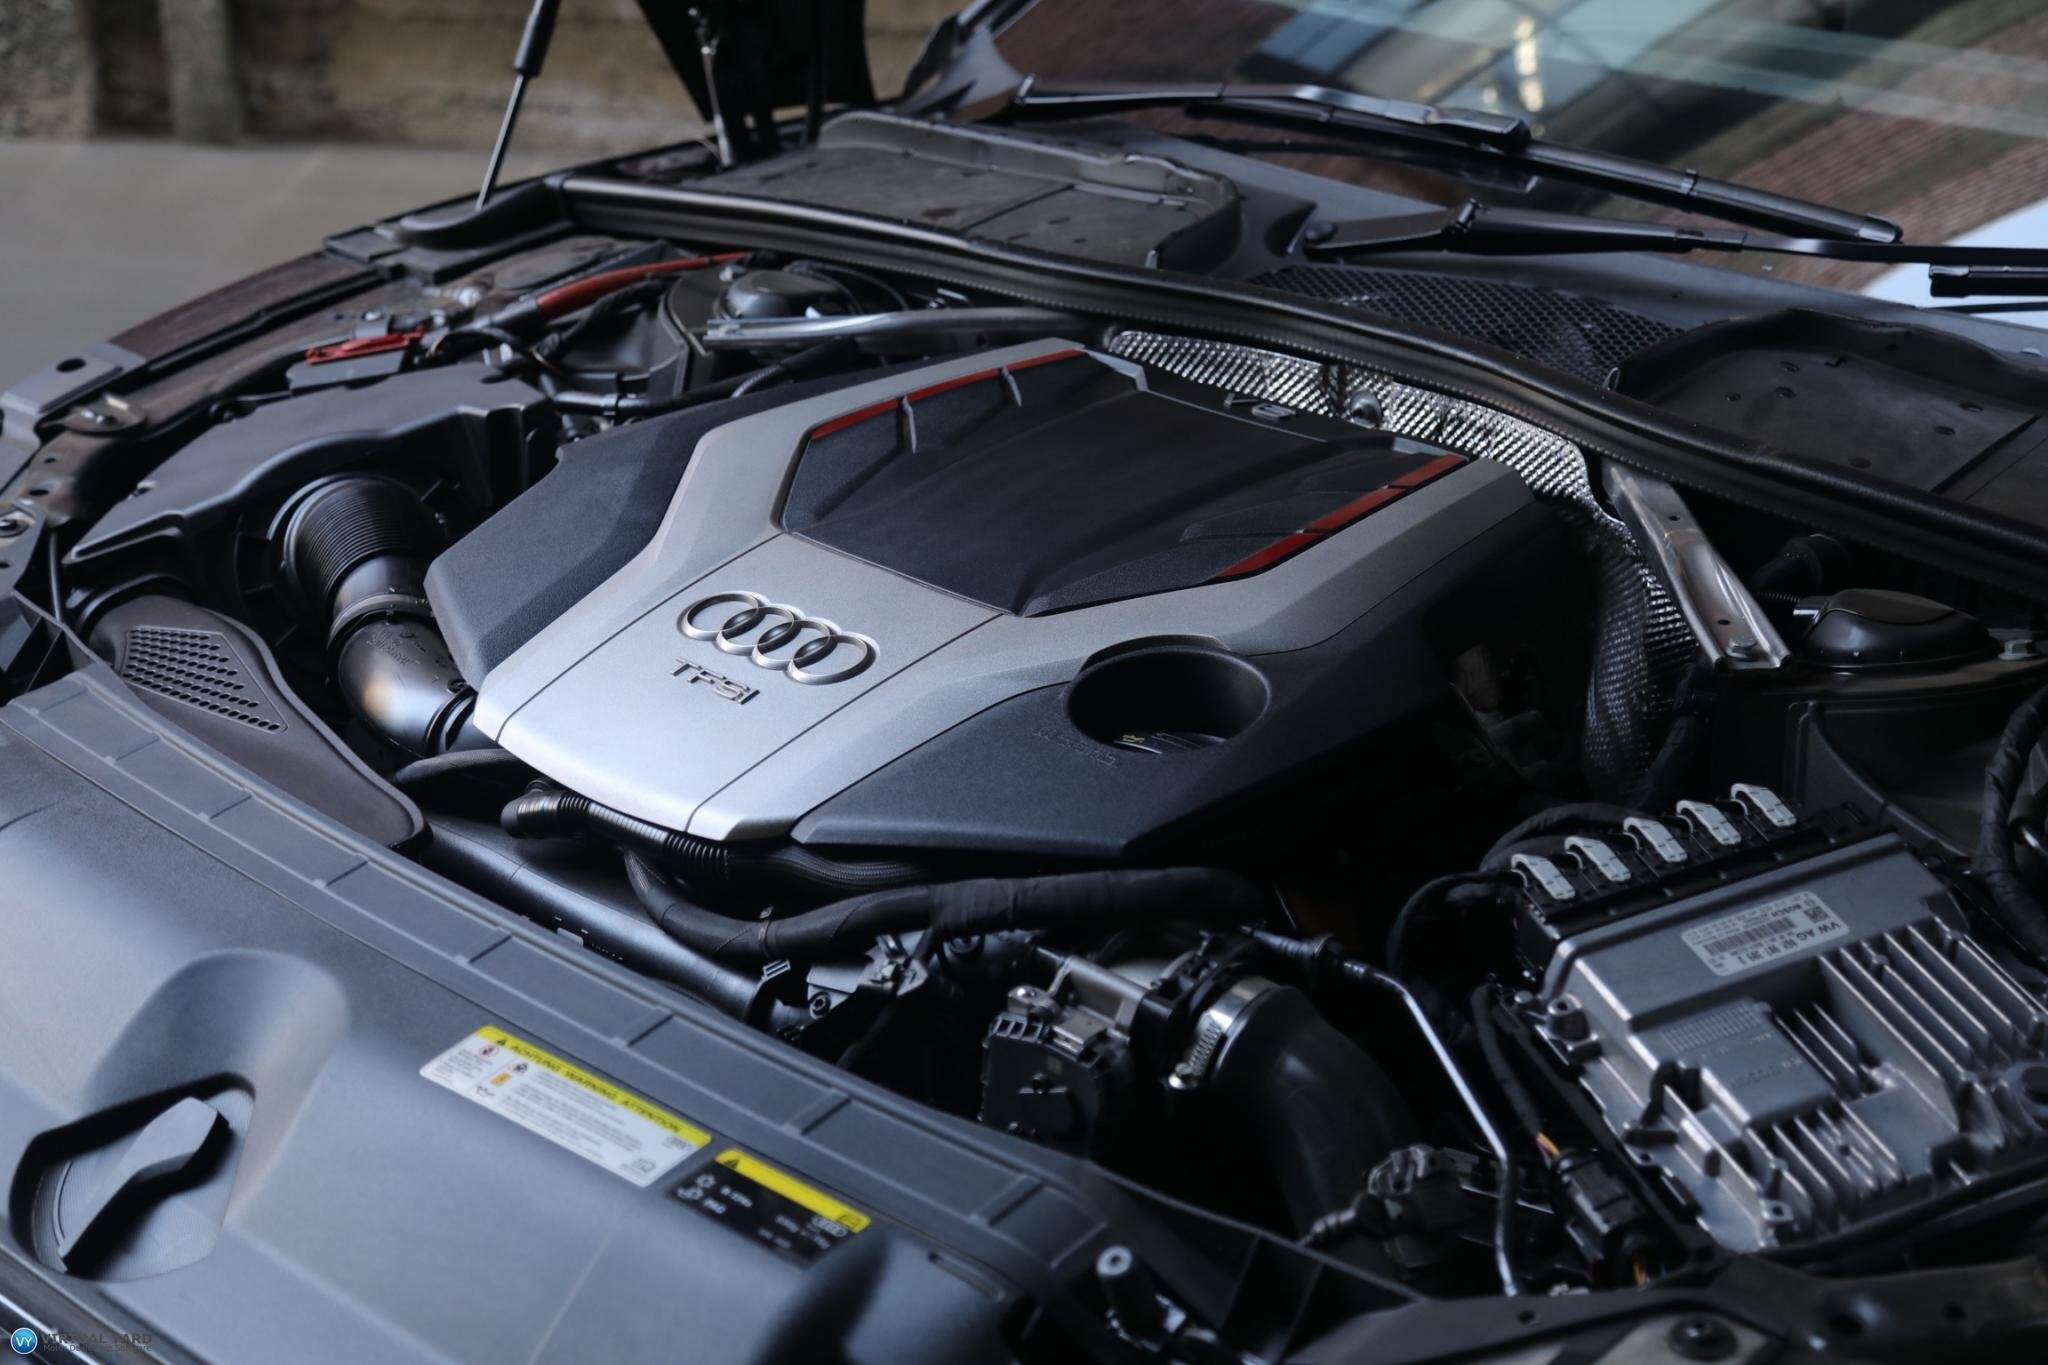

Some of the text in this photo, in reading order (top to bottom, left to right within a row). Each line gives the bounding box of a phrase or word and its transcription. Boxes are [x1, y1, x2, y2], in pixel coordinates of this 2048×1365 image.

[670, 656, 760, 705] TFSI
[1795, 921, 1842, 942] VW AG
[511, 1045, 562, 1073] ACHTUNG
[564, 1071, 618, 1098] WARNING
[620, 1099, 680, 1132] ATTENTION
